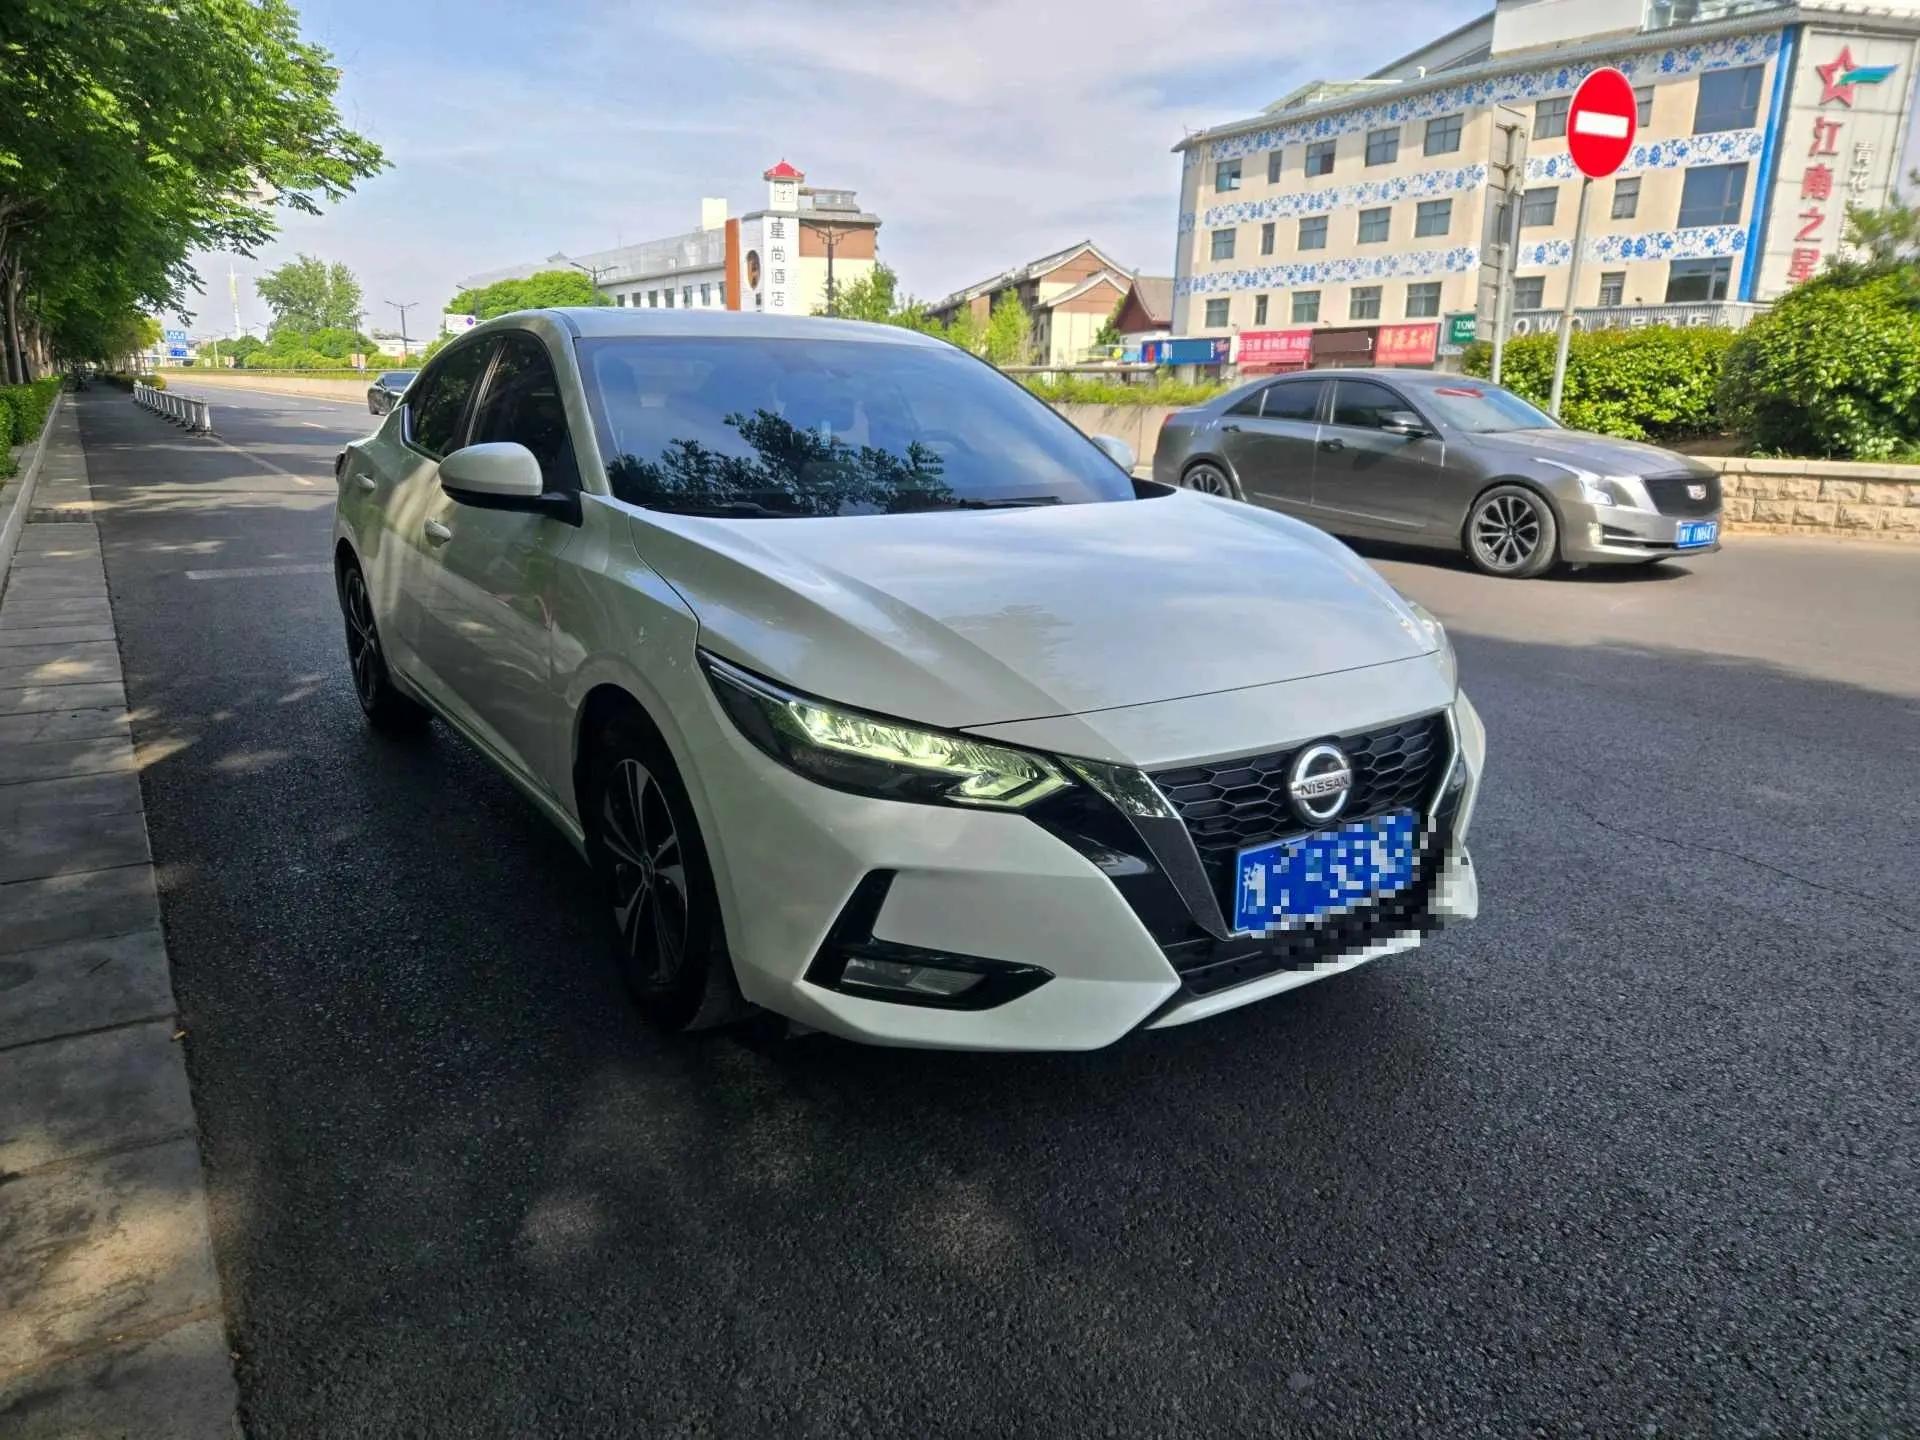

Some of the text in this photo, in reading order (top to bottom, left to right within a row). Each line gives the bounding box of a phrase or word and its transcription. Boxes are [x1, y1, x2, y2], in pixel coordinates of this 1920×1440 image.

[1786, 116, 1844, 285] 江南之星
[1300, 775, 1348, 795] NISSAN
